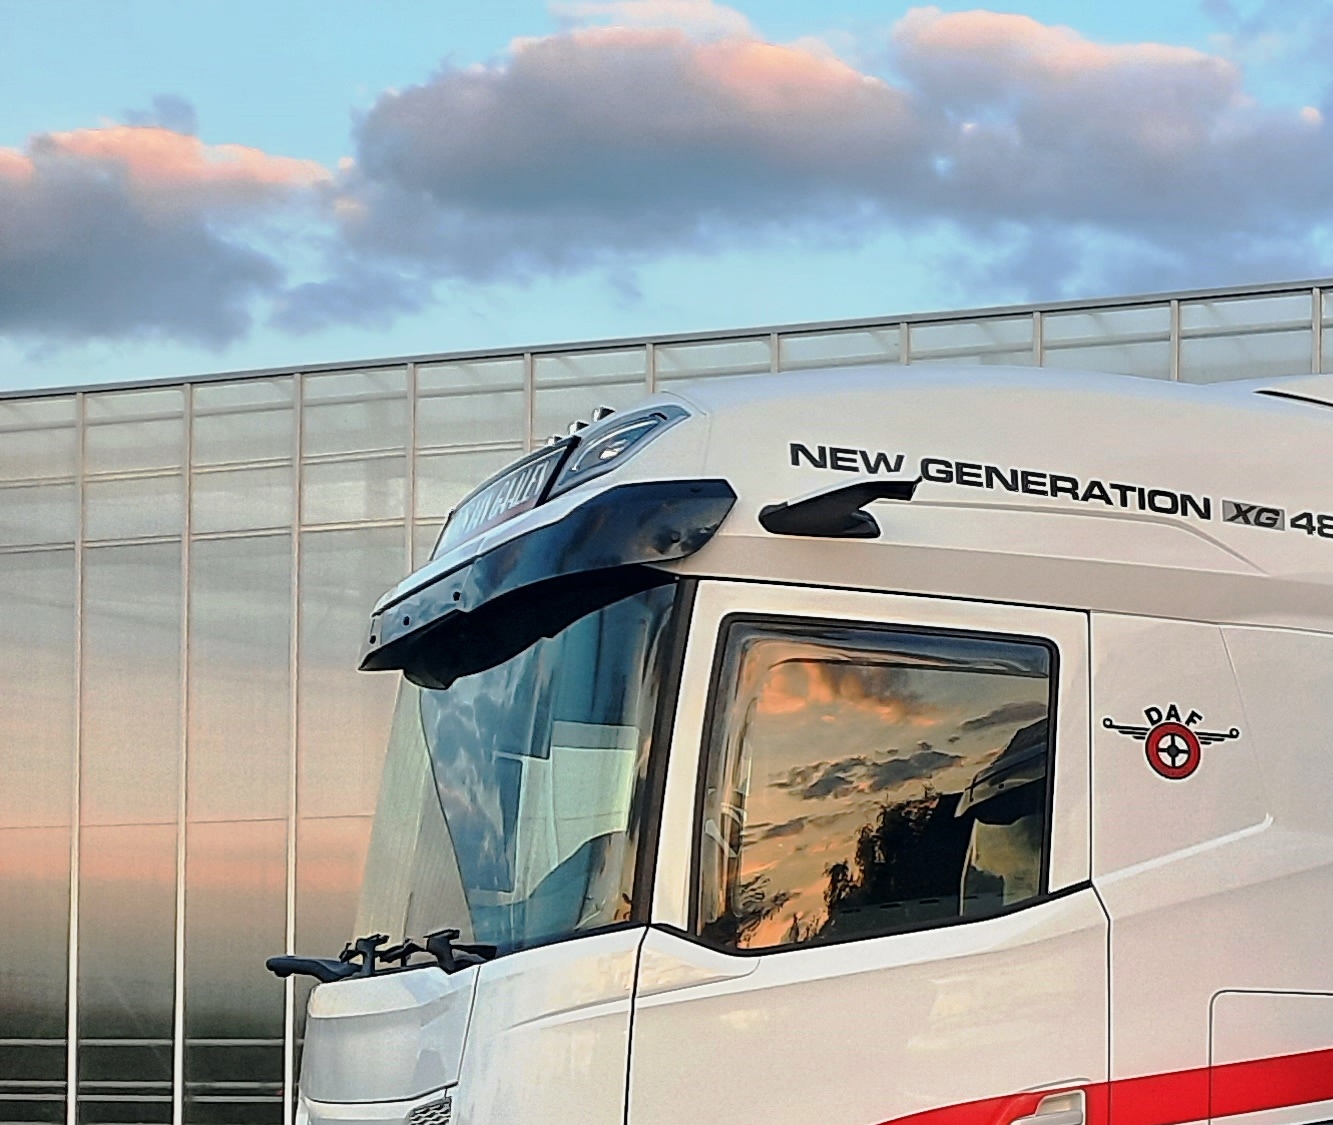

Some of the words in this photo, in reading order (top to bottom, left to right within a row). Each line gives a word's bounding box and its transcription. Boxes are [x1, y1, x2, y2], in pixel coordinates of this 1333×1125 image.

[789, 443, 905, 475] NEW
[920, 457, 1211, 521] GENERATION
[1226, 502, 1281, 529] XG
[1143, 703, 1203, 727] DAF
